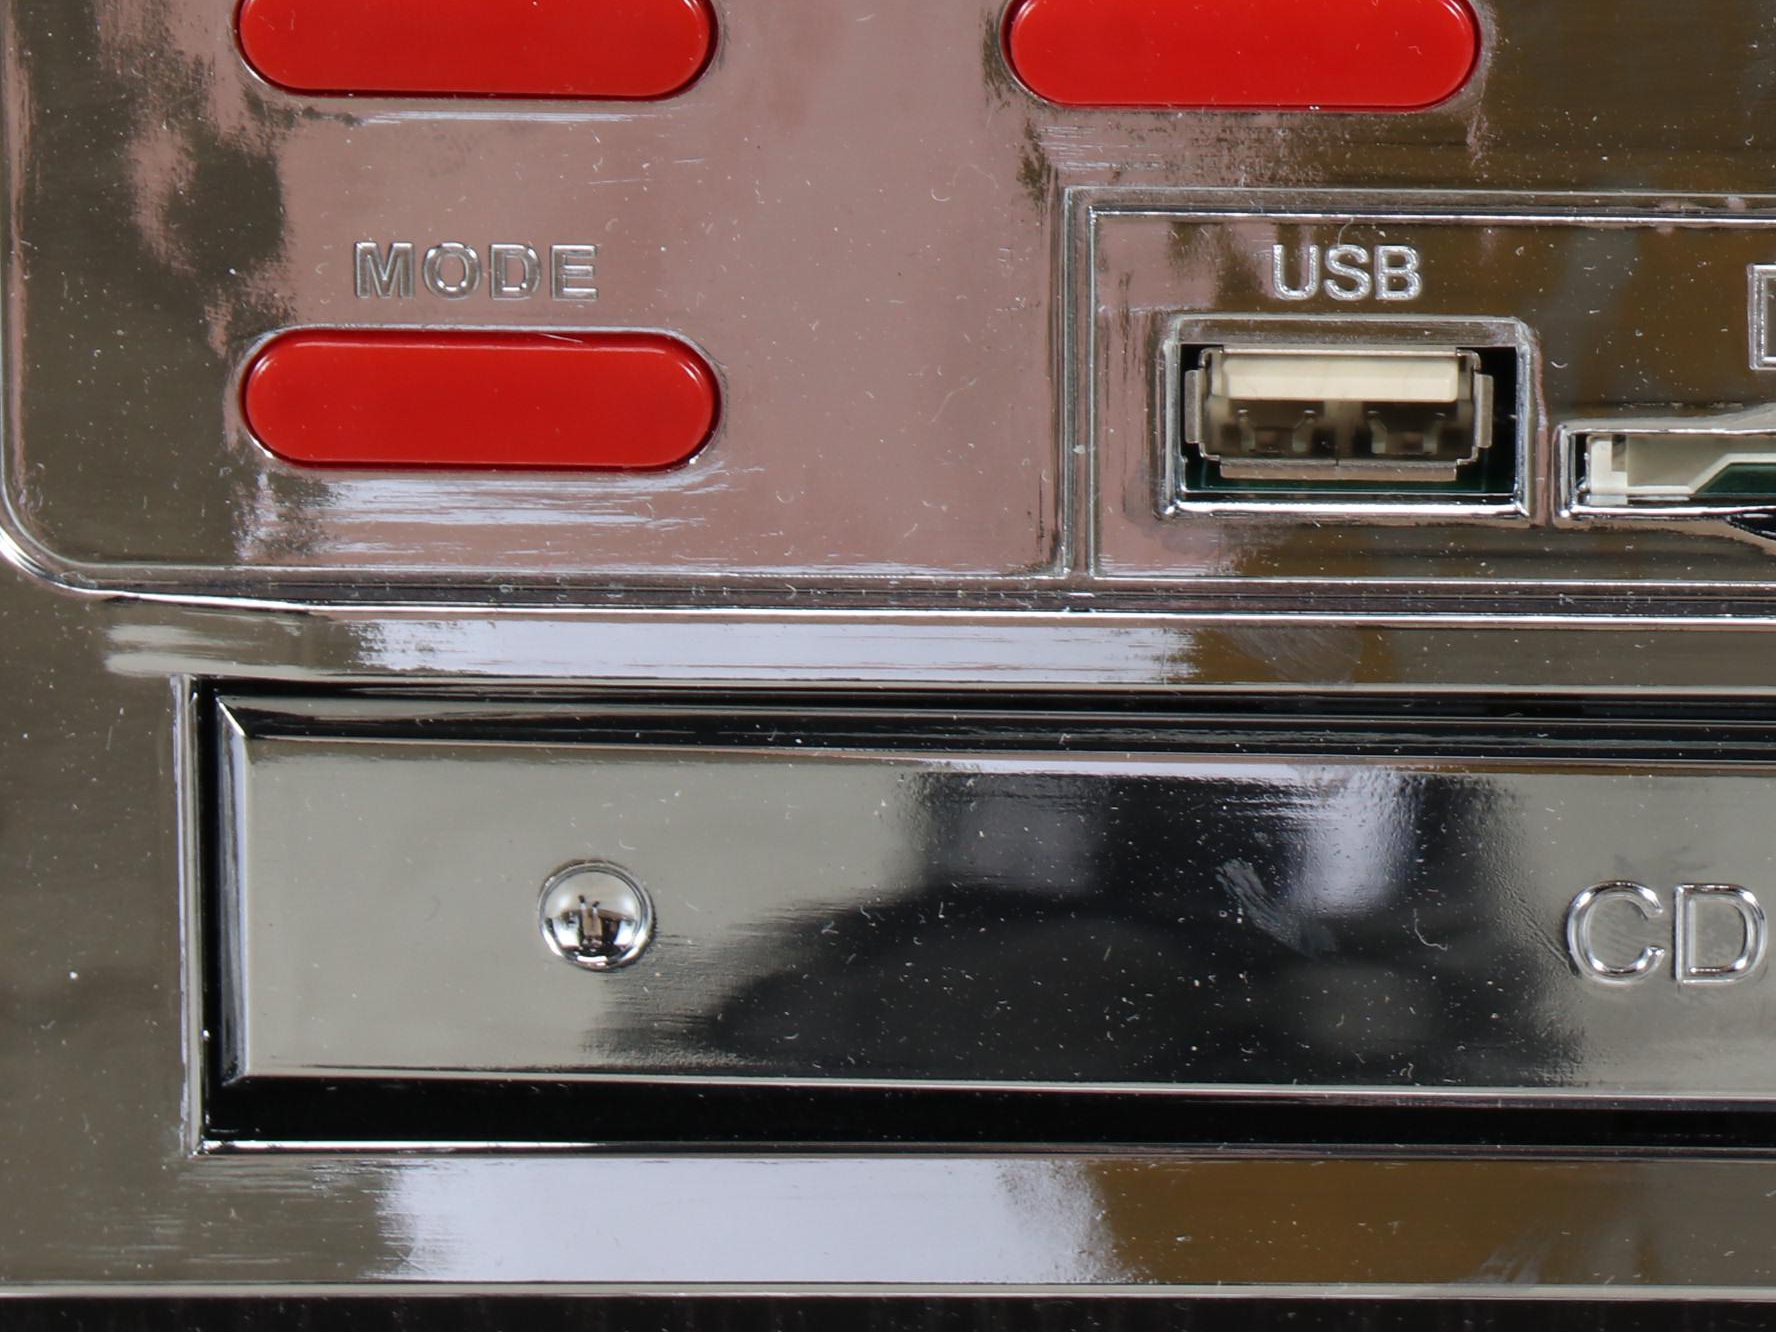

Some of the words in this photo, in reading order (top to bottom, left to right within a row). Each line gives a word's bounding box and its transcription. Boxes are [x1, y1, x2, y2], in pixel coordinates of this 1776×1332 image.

[354, 241, 600, 302] MODE
[1271, 243, 1424, 302] USB
[1566, 880, 1769, 986] CD
